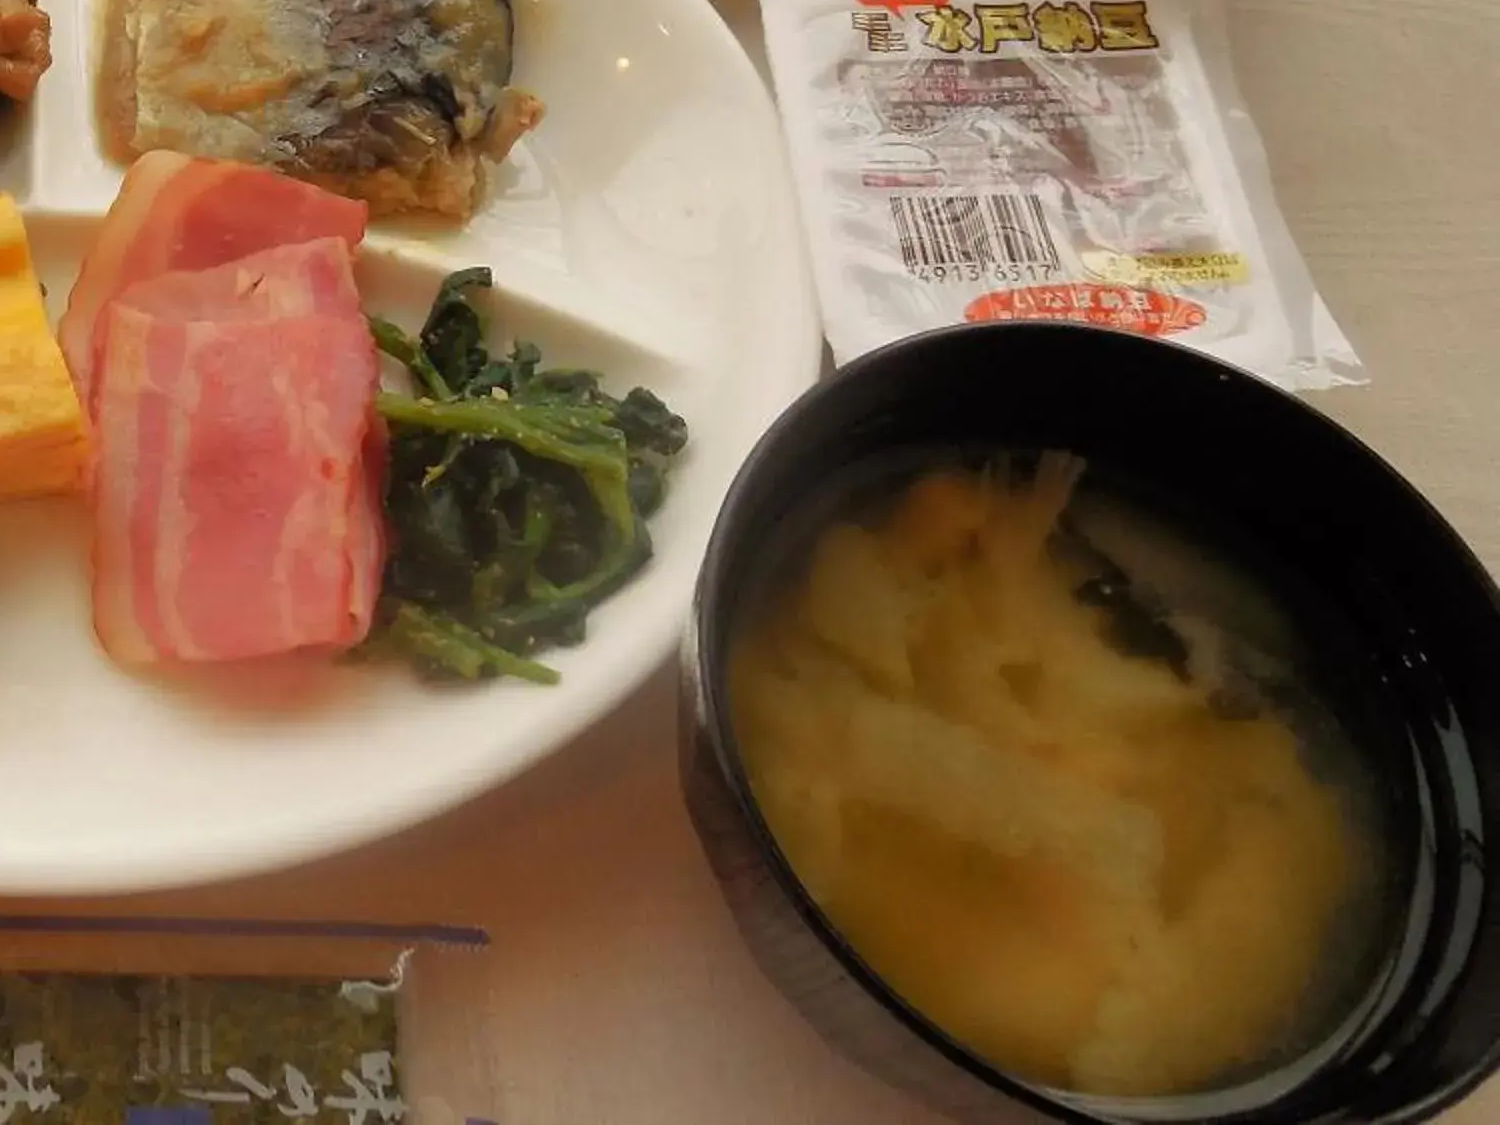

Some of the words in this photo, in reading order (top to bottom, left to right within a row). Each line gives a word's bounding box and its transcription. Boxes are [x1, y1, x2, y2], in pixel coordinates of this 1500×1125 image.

[915, 0, 1160, 54] 水戸納豆
[916, 264, 981, 285] 4913
[993, 263, 1053, 284] 6517
